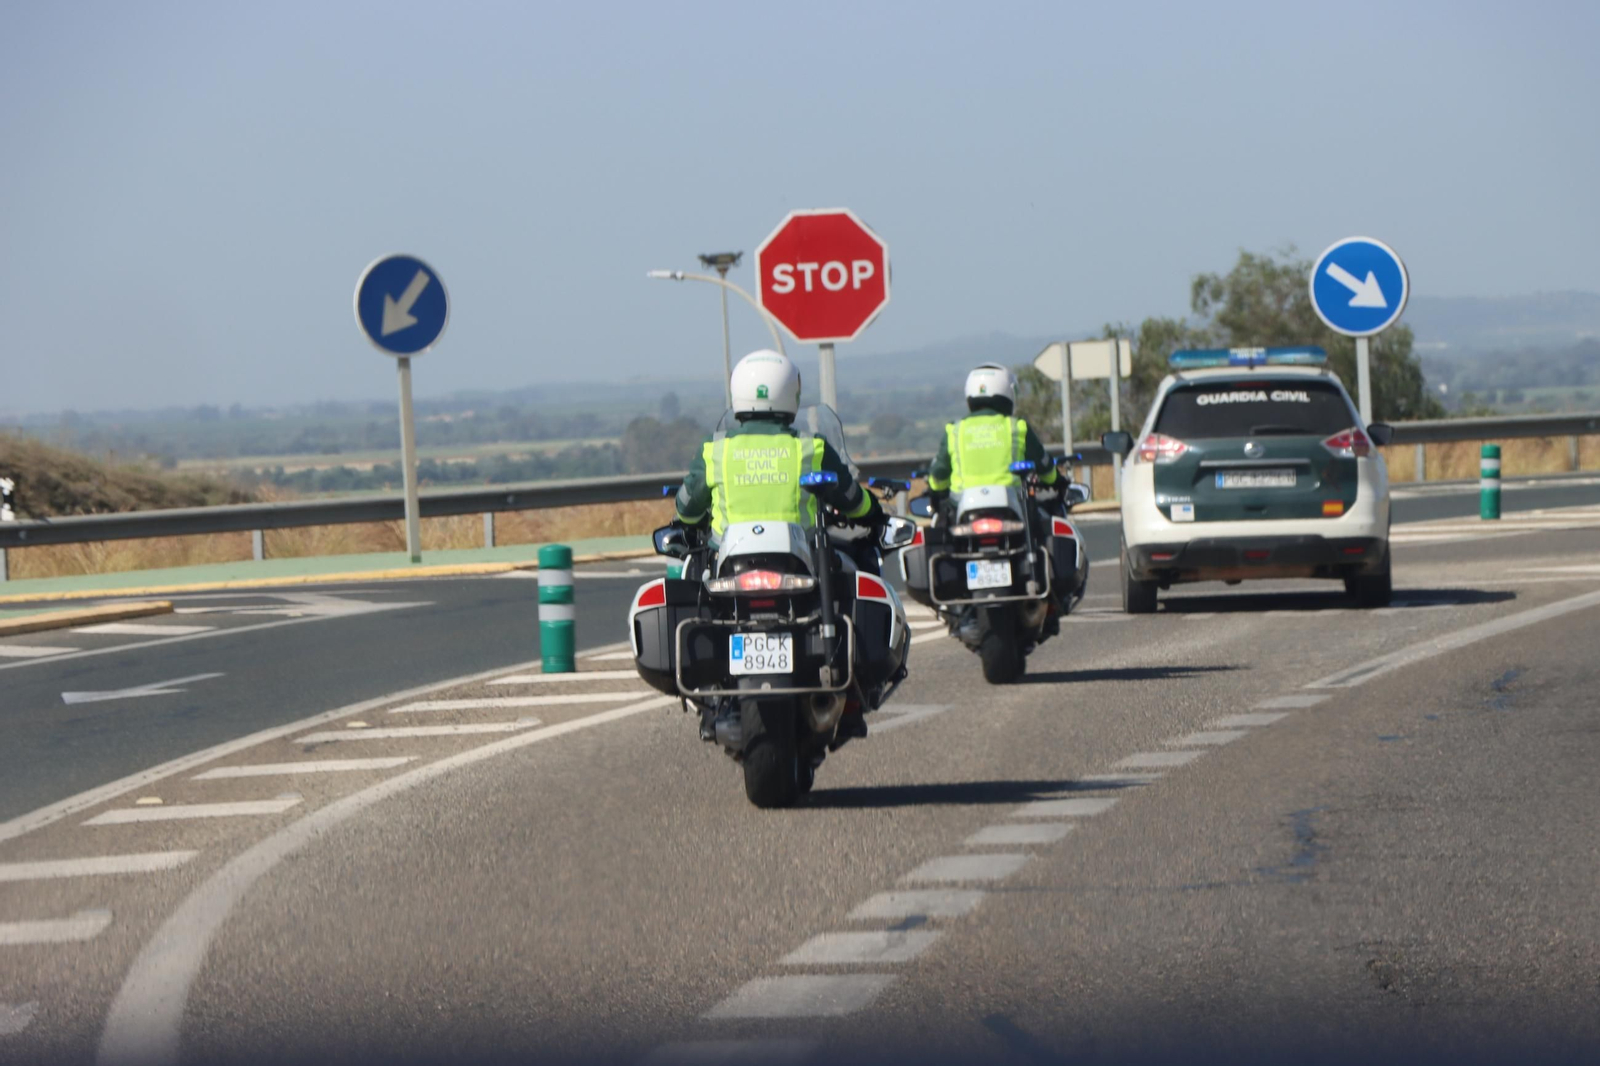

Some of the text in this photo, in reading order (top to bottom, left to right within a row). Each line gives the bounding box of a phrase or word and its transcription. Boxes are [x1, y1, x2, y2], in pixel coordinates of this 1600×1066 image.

[772, 260, 875, 294] STOP
[1196, 390, 1311, 406] GUARDIA CIVIL
[733, 448, 789, 459] GUARDIA
[747, 459, 775, 470] CIVIL
[736, 470, 788, 484] TRÁFICO
[743, 635, 788, 652] PGCK
[744, 654, 788, 670] 8948
